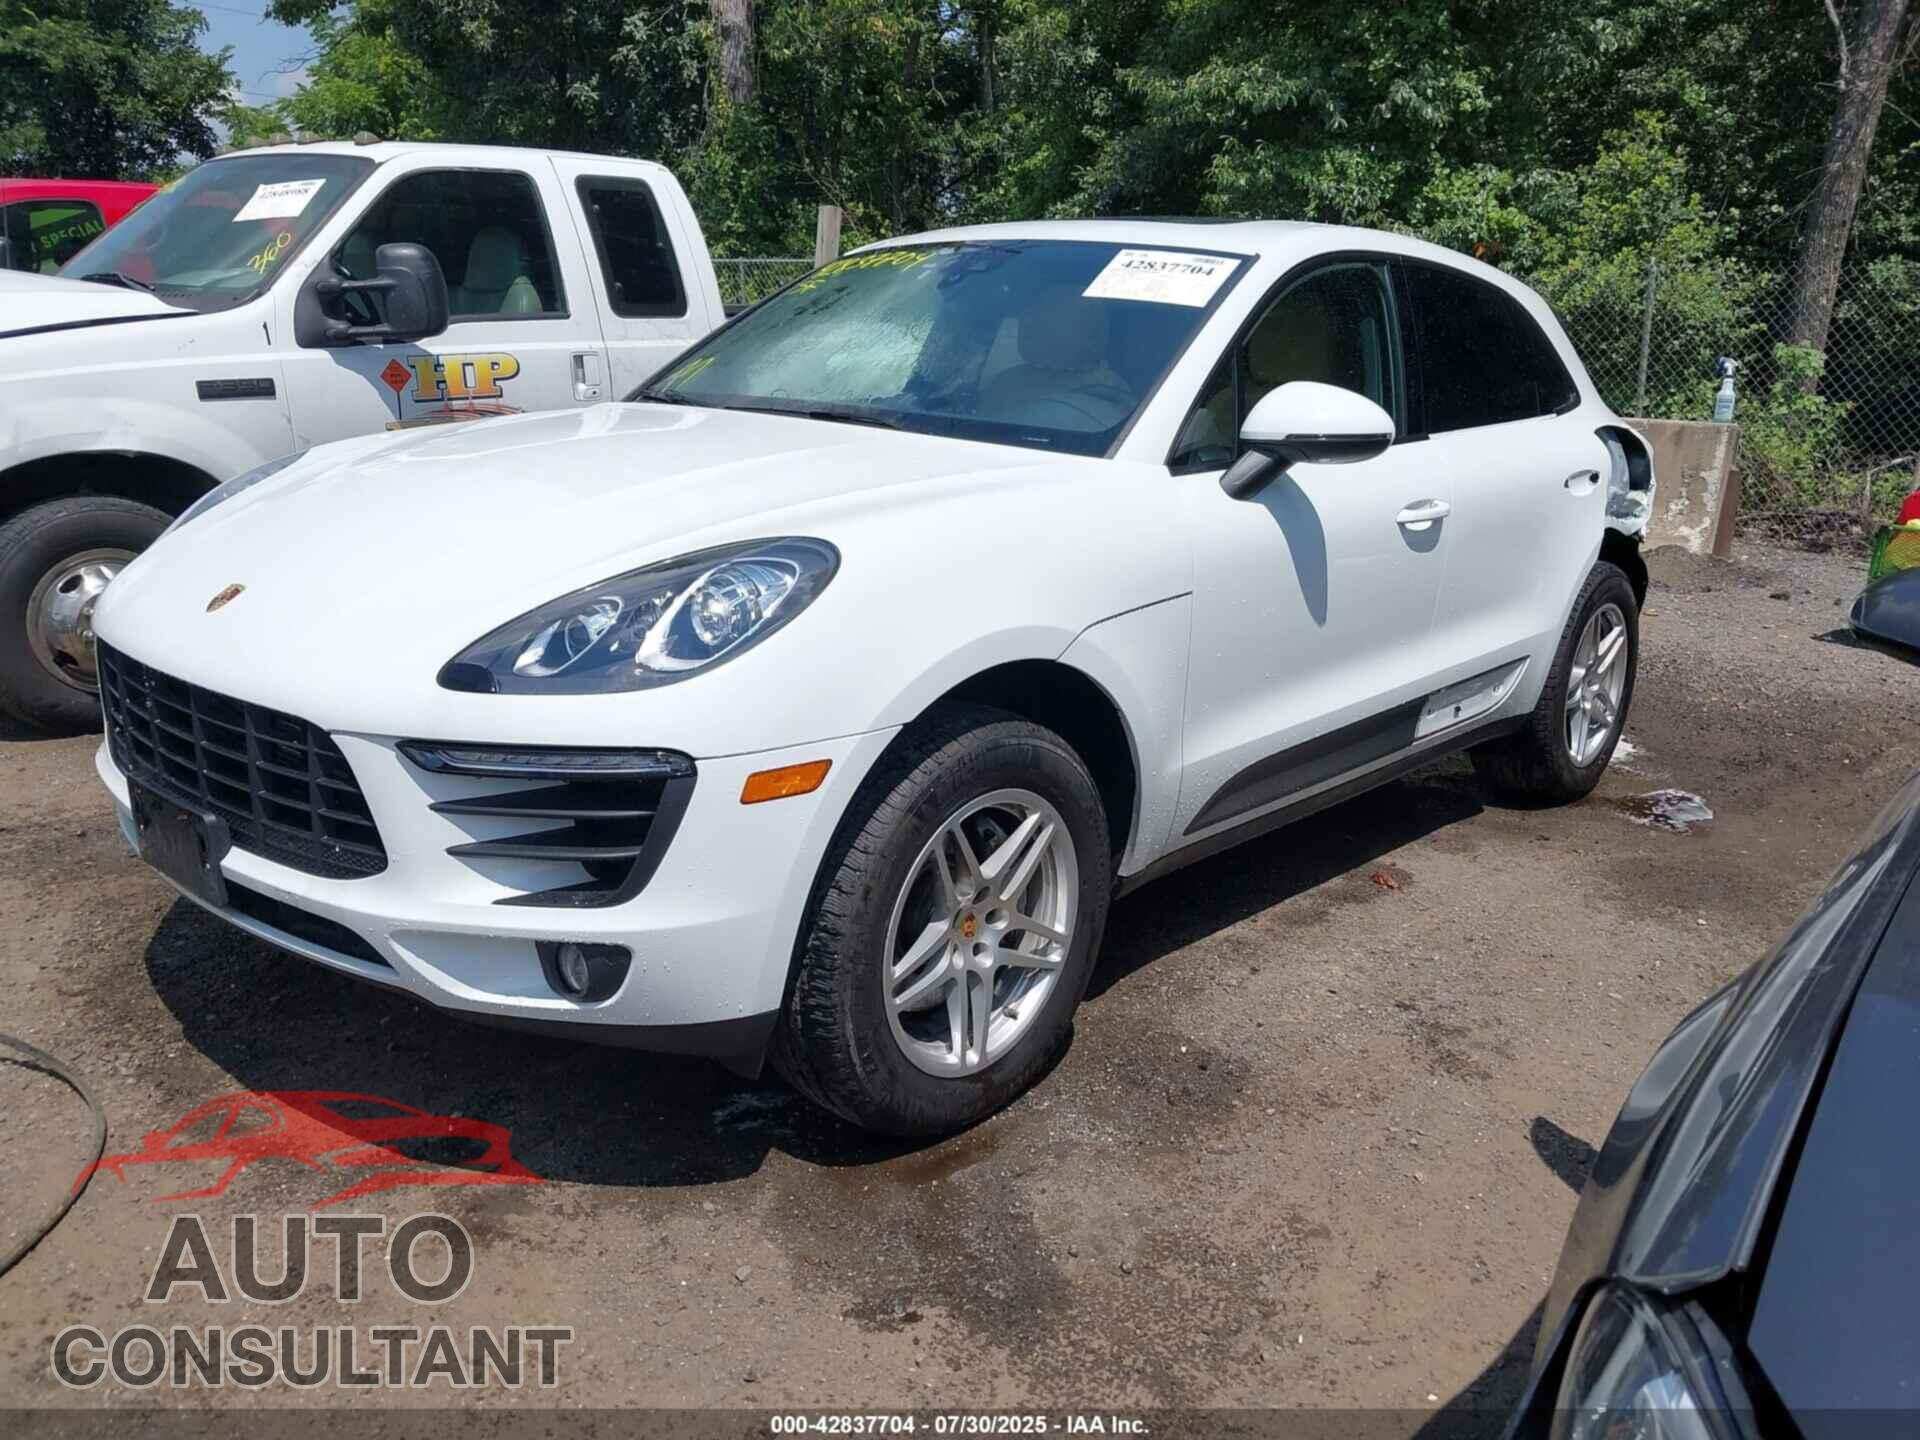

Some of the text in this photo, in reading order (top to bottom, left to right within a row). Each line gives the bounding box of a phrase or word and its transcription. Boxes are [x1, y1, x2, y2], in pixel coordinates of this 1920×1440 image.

[40, 219, 102, 249] SPECIAL
[1121, 258, 1215, 276] 42837704
[407, 352, 520, 402] HP
